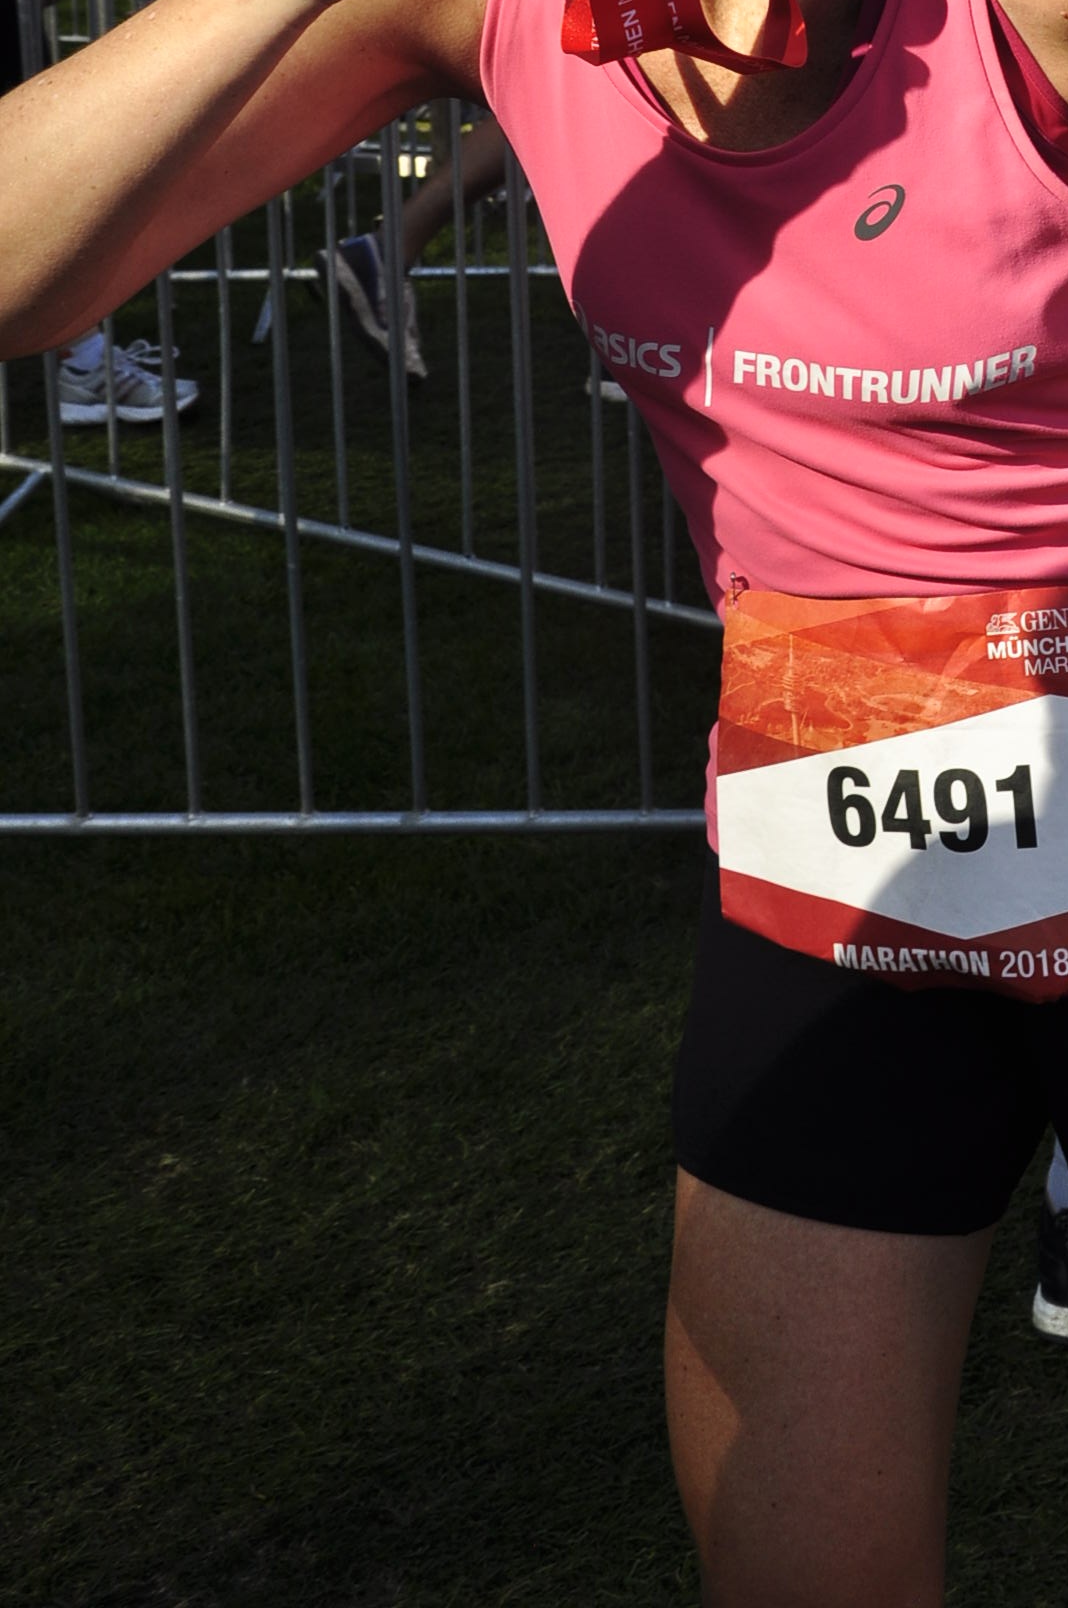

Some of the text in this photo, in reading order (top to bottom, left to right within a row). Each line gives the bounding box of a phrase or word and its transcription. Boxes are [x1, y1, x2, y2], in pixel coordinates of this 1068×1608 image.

[733, 344, 1038, 405] FRONTRUNNER
[826, 763, 1040, 854] 6491
[833, 942, 990, 978] MARATHON
